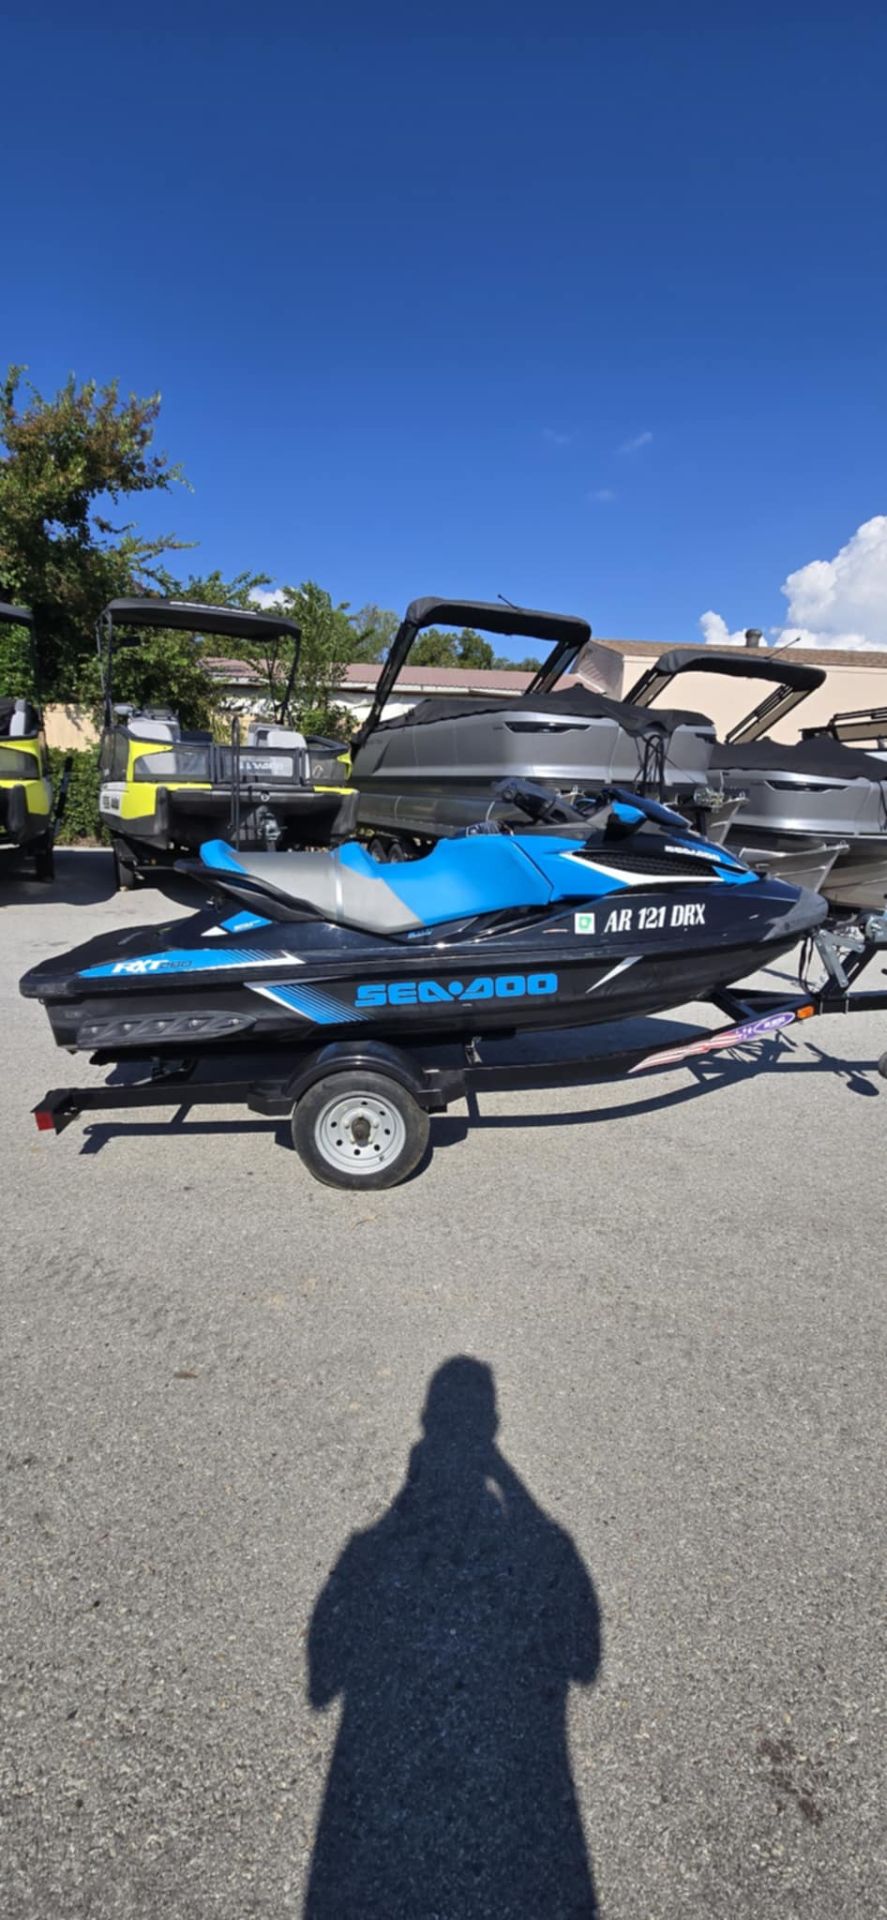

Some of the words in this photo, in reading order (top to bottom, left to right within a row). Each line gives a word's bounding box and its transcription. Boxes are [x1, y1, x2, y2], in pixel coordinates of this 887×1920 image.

[603, 908, 633, 933] AR
[638, 905, 667, 930] 121
[670, 903, 706, 927] DRX
[111, 959, 169, 974] RXT
